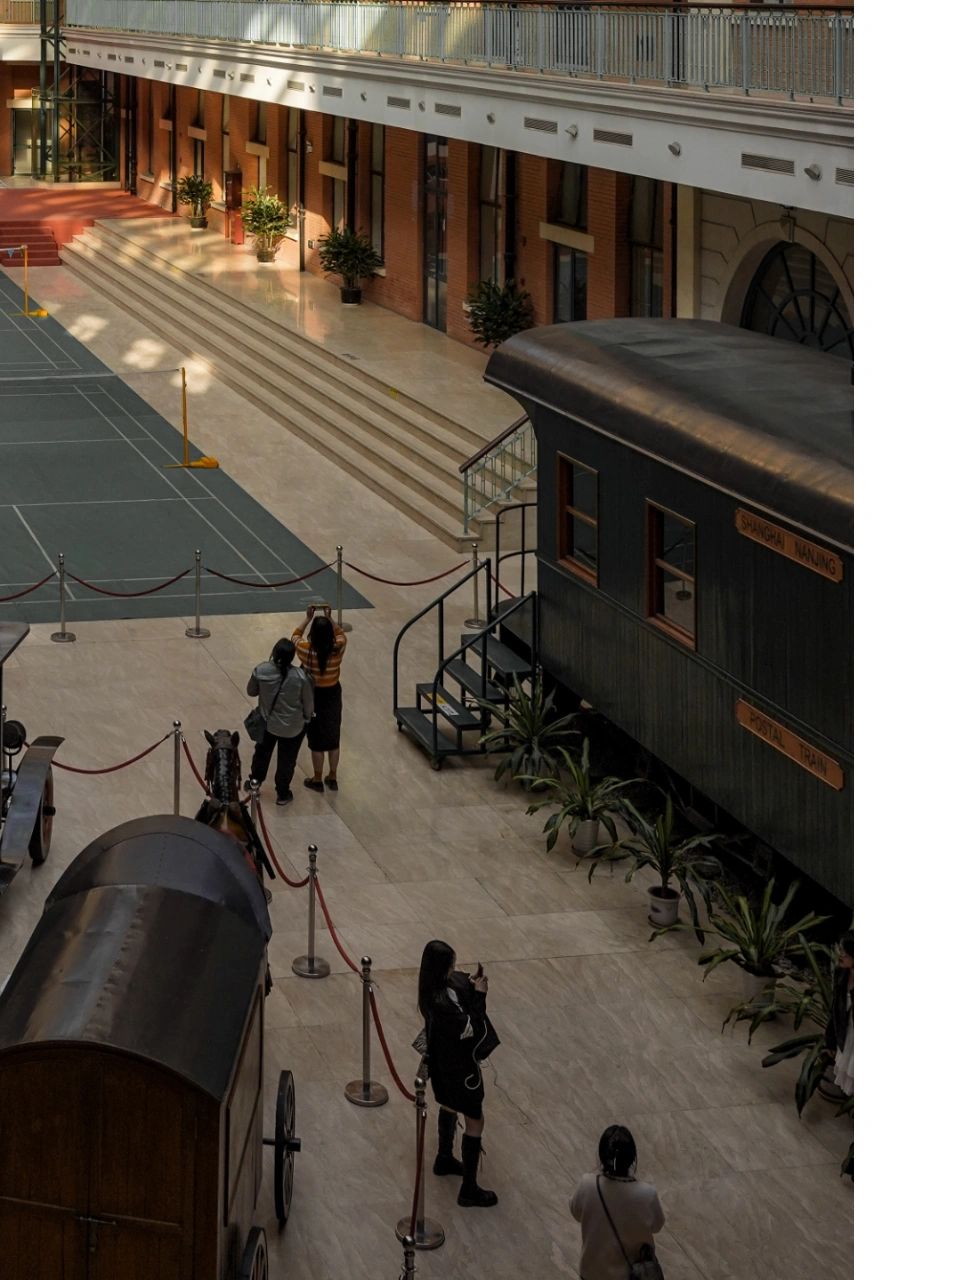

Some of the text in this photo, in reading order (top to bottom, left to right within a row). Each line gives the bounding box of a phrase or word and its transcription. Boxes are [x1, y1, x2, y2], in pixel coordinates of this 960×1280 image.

[741, 515, 836, 576] SHANGHAI NANJING
[750, 711, 827, 777] POSTAL TRAIN
